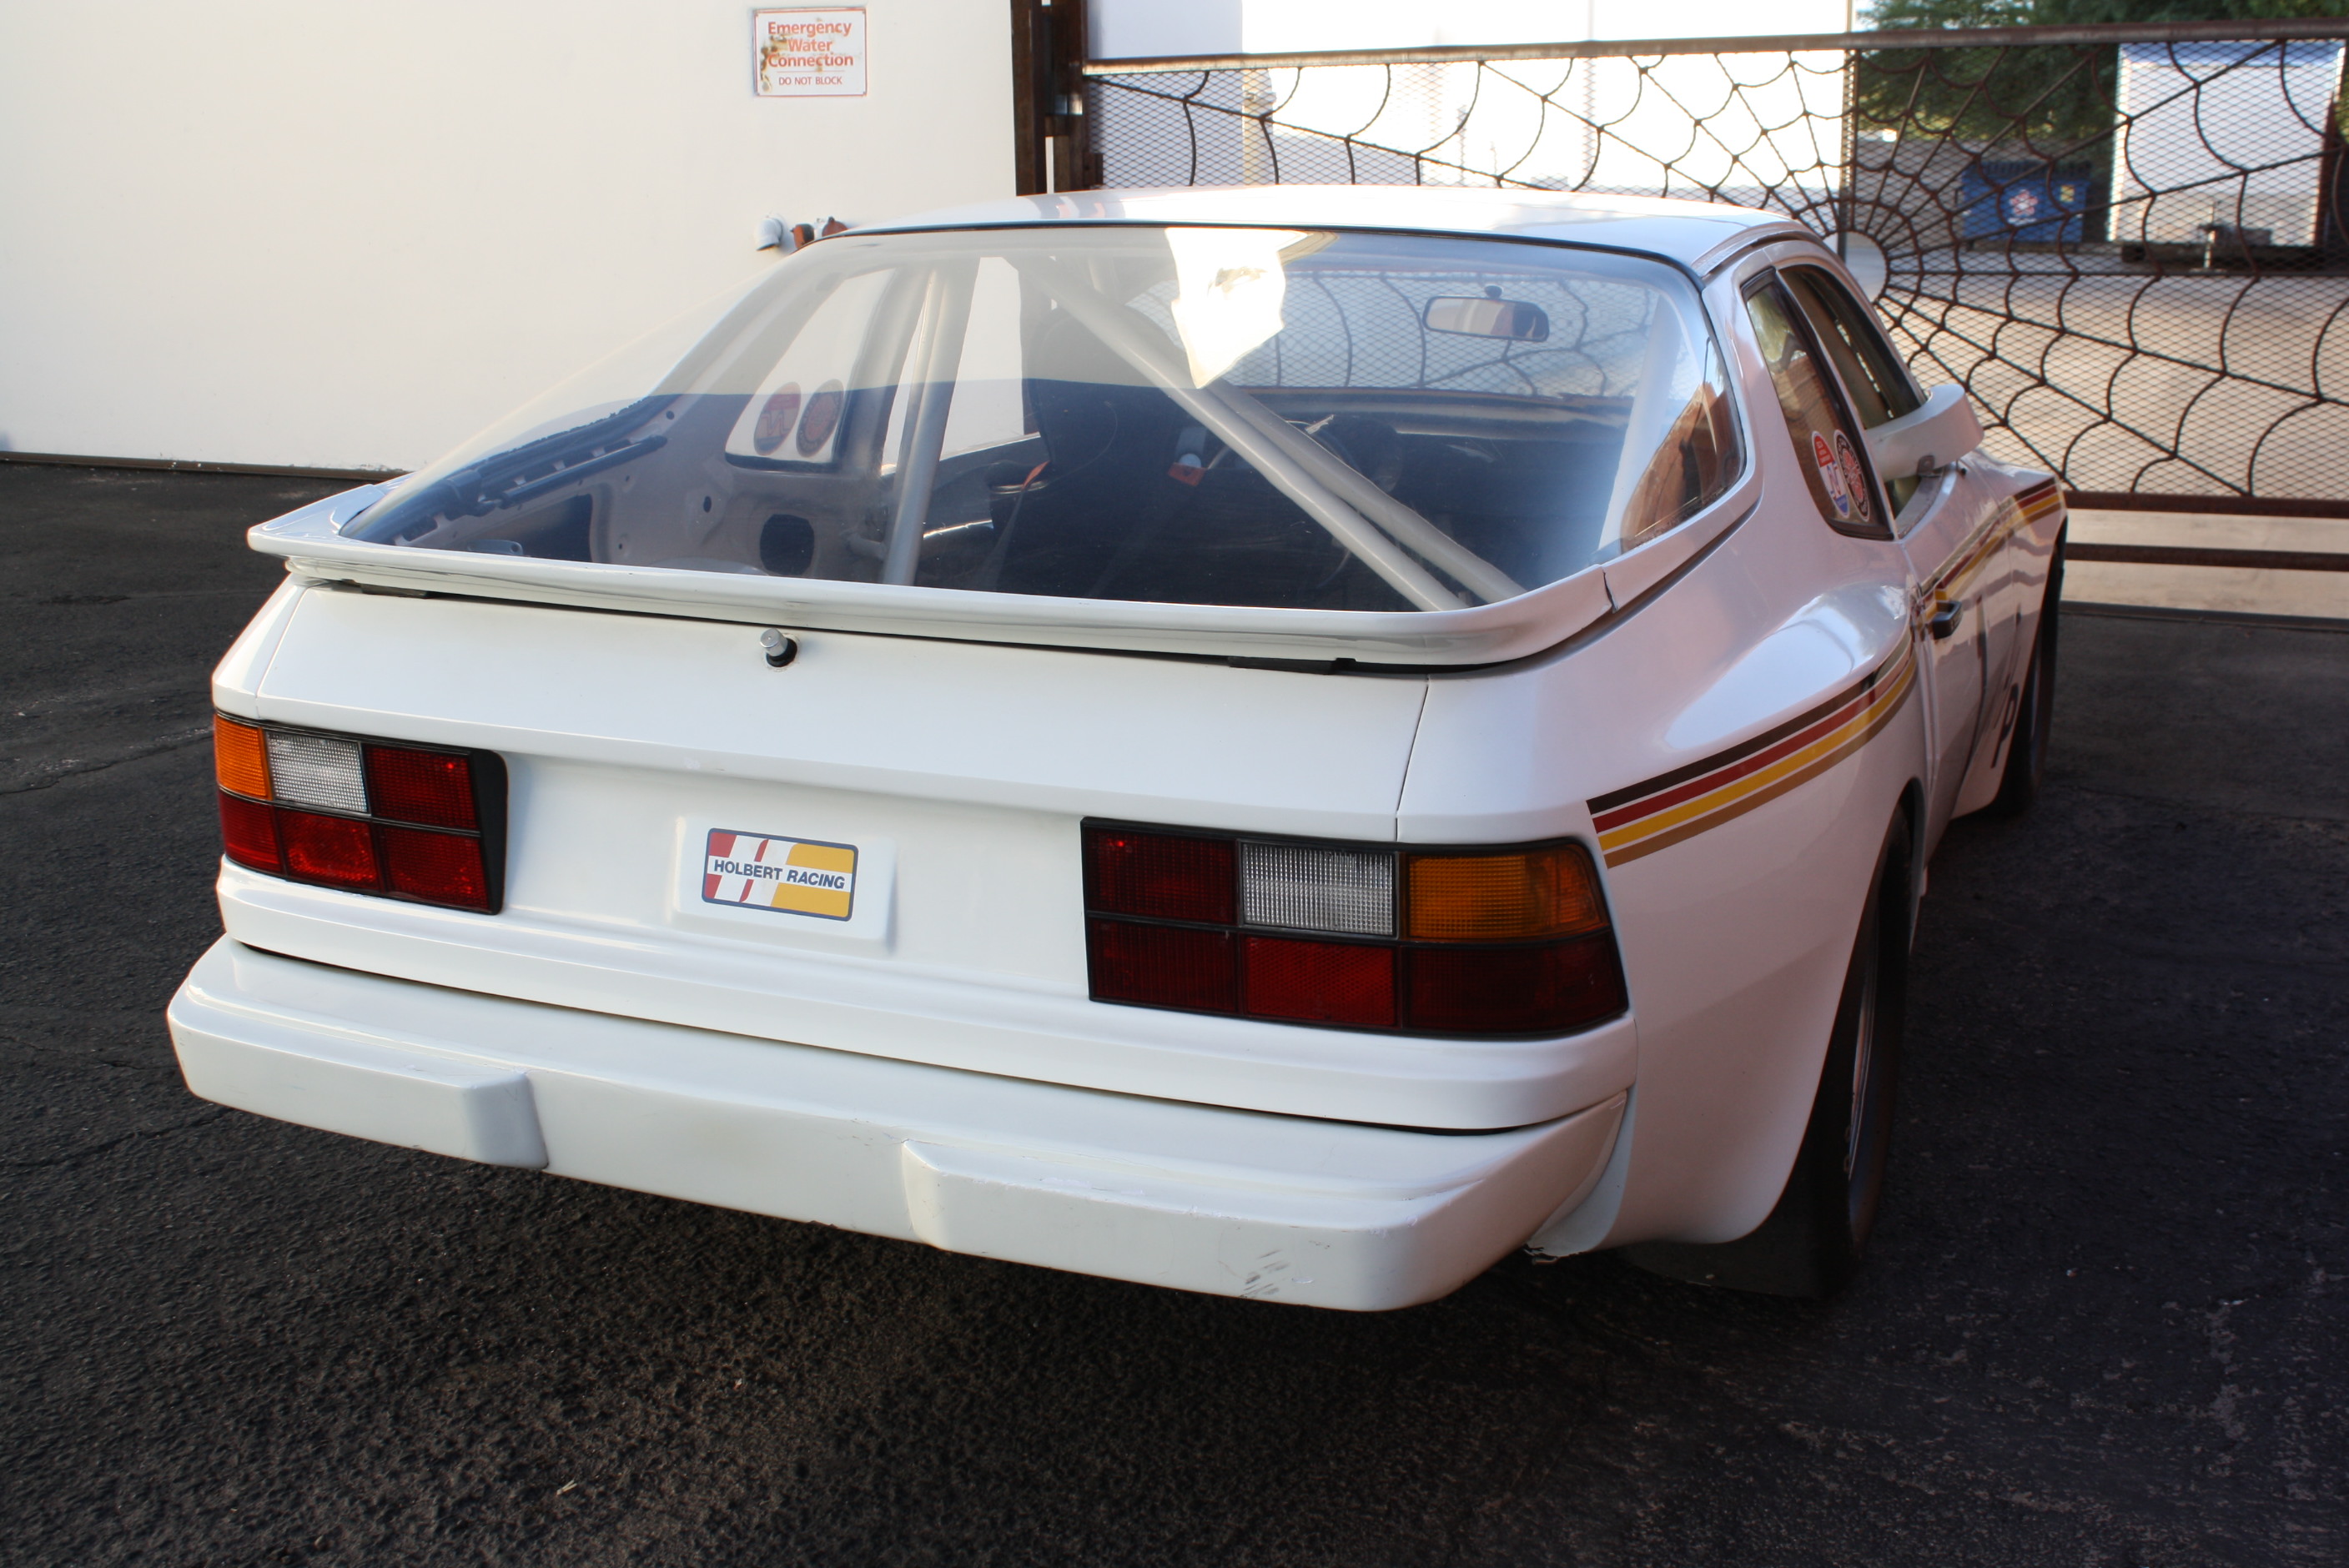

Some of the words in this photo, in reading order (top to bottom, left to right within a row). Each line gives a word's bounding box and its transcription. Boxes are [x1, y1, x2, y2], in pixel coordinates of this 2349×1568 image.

[767, 21, 853, 38] Emergency
[787, 38, 832, 52] Water
[767, 53, 853, 68] Connection
[778, 77, 792, 85] DO
[794, 77, 812, 85] NOT
[815, 76, 843, 85] BLOCK
[713, 859, 783, 880] HOLBERT
[786, 869, 846, 889] RACING
